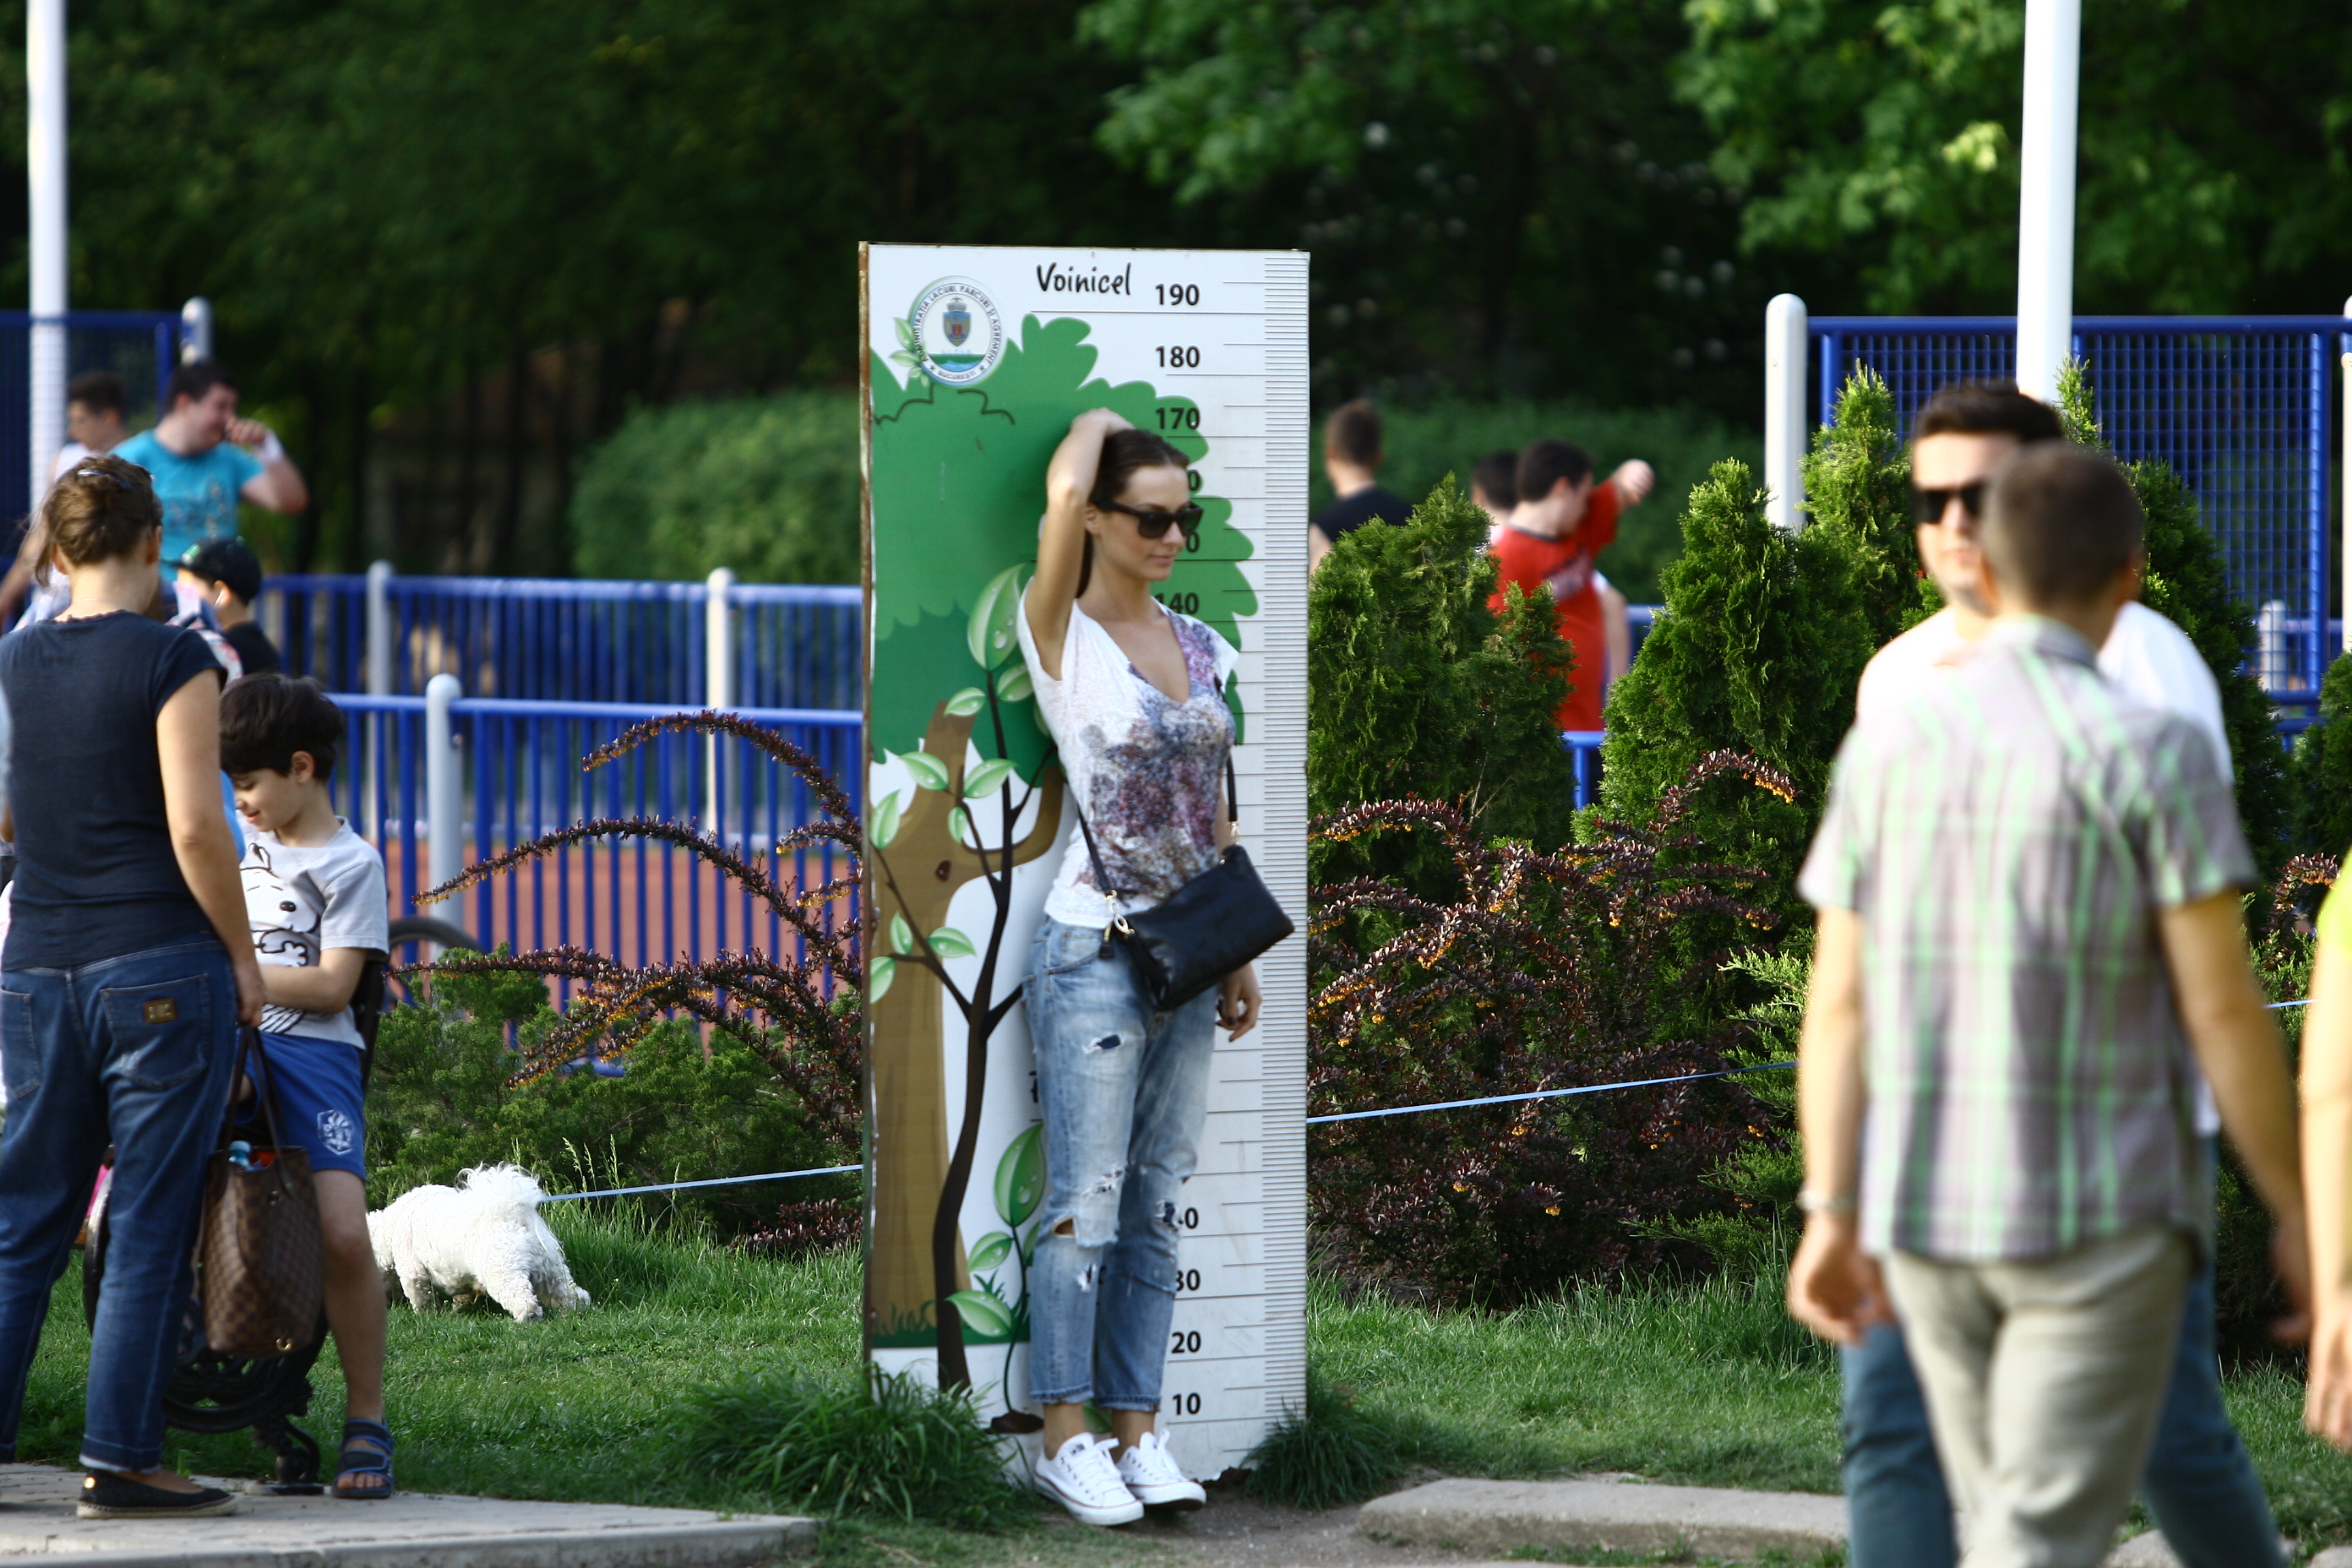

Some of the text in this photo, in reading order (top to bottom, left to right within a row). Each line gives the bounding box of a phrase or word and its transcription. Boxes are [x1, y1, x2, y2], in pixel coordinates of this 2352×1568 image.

[1036, 261, 1131, 295] Voinicel
[1155, 283, 1200, 306] 190
[1155, 345, 1200, 368] 180
[1156, 407, 1200, 429] 170
[1171, 1331, 1201, 1354] 20
[1173, 1393, 1201, 1416] 10
